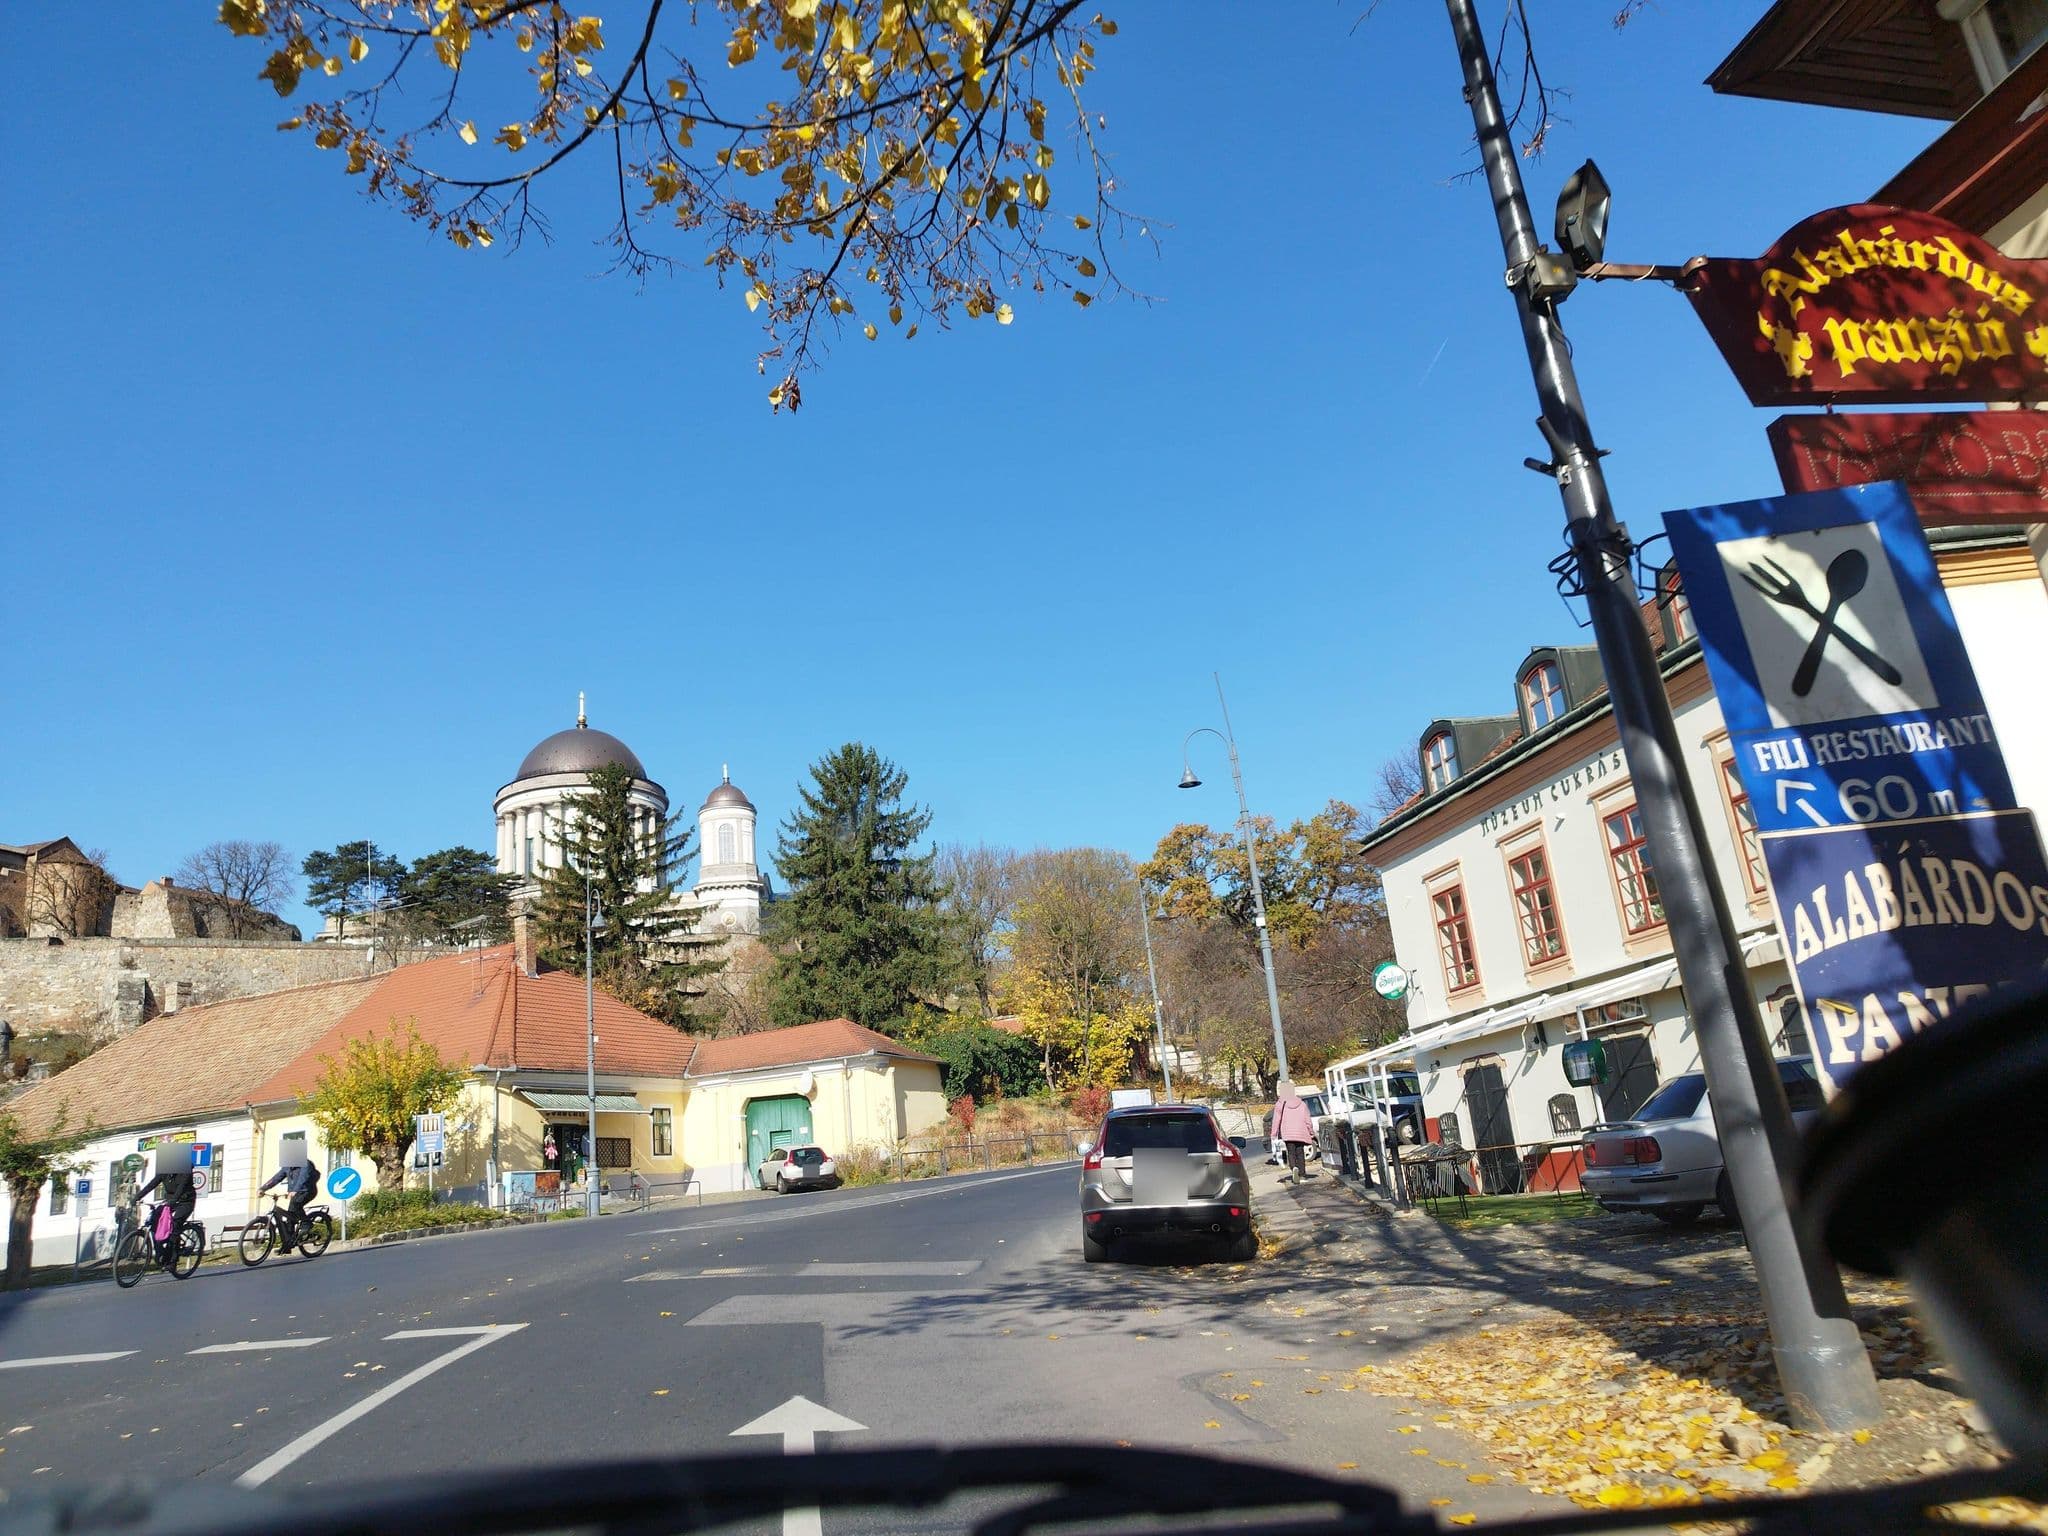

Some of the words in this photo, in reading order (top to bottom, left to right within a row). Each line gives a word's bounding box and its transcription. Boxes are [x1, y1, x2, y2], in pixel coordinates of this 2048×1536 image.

[1761, 225, 2034, 317] Alabárdos
[1822, 302, 2014, 378] panzió
[1752, 737, 1810, 772] FILI
[1809, 714, 1992, 766] RESTAURANT
[1480, 791, 1543, 837] MÚZEUM
[1551, 752, 1621, 802] CUKRÁS
[1838, 775, 1919, 823] 60
[1928, 789, 1958, 816] m
[1816, 982, 2000, 1065] PAN
